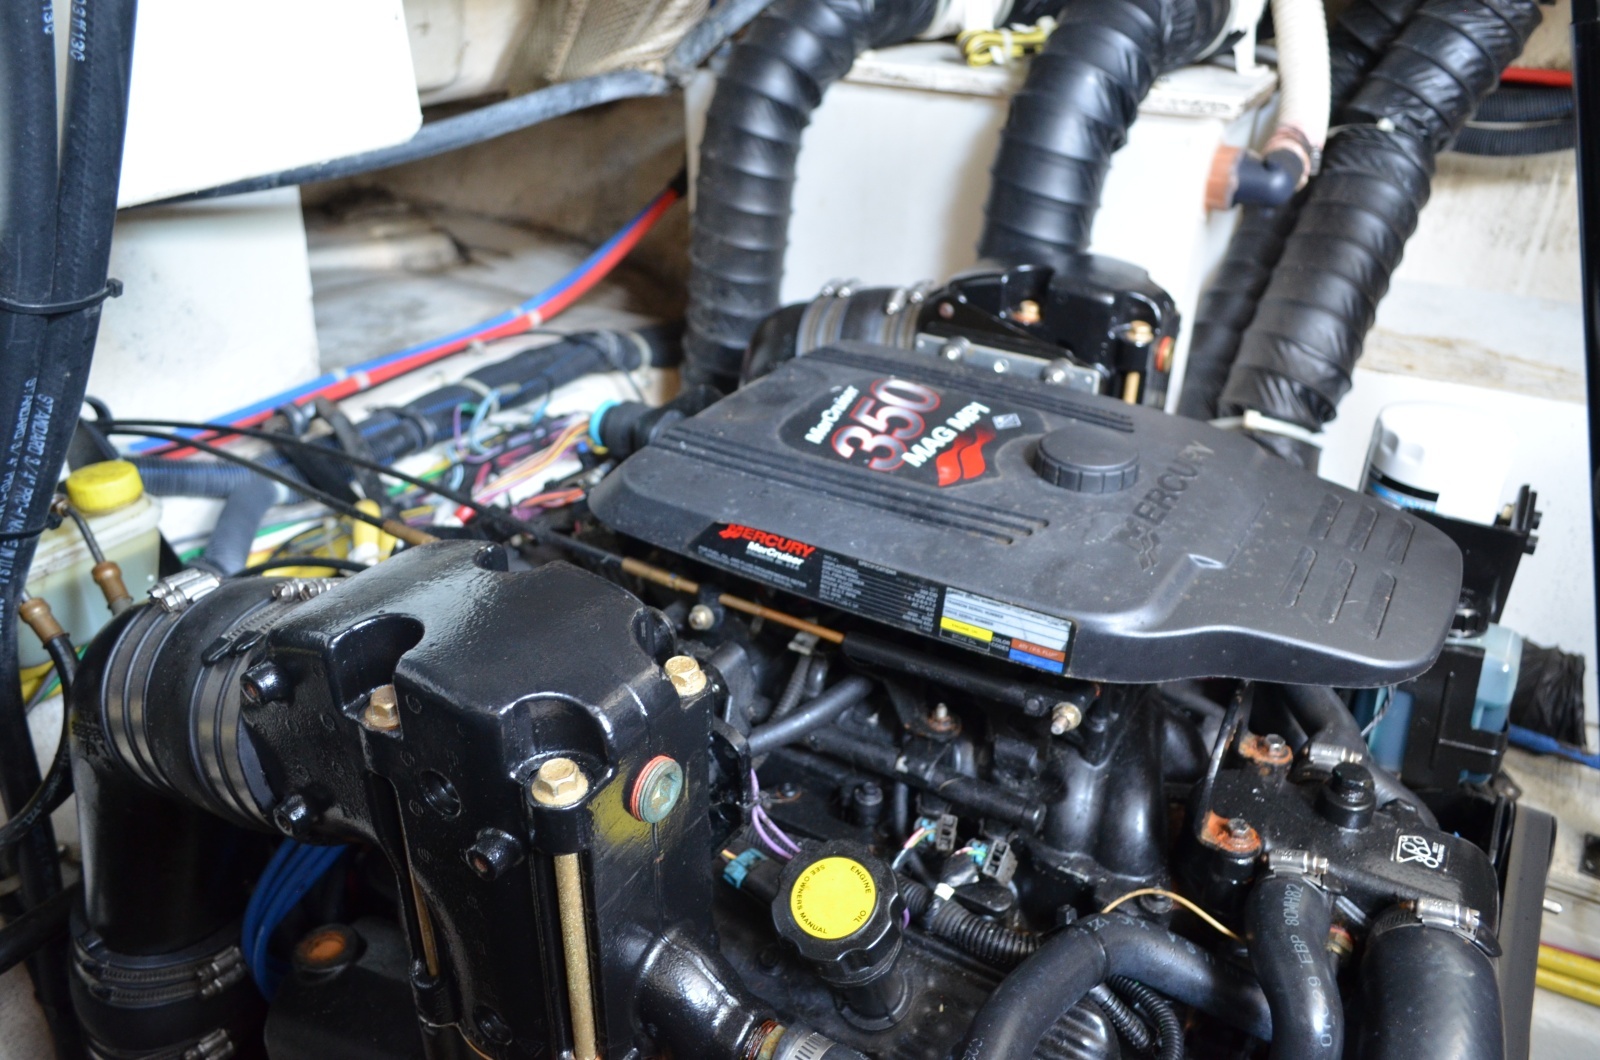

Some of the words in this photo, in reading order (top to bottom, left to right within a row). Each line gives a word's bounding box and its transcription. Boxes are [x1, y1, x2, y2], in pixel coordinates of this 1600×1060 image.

[27, 393, 54, 456] STANDARD
[831, 378, 941, 471] 350
[902, 426, 958, 467] MAG
[946, 401, 991, 432] MPI
[719, 523, 816, 558] MERCURY
[746, 541, 804, 565] MerCruiser
[991, 642, 1010, 652] CODES
[993, 636, 1011, 646] COLOR
[811, 864, 826, 876] SEE
[850, 865, 872, 894] ENGINE
[796, 876, 810, 911] OWNERS
[799, 912, 828, 934] MANUAL
[853, 910, 867, 923] OIL
[1290, 934, 1314, 964] EBP
